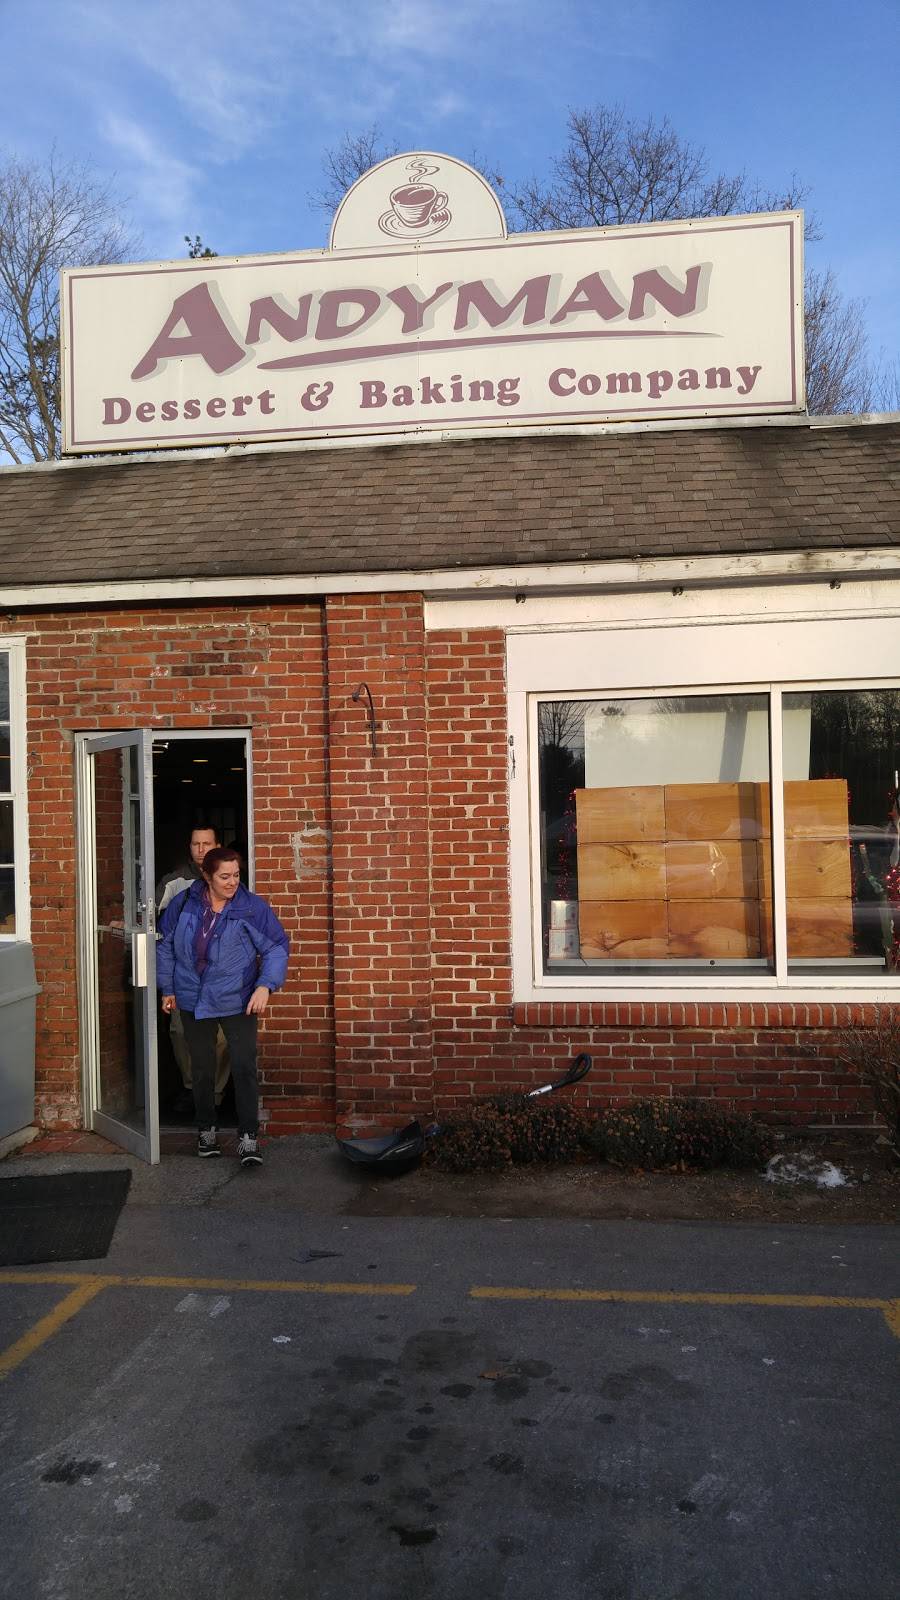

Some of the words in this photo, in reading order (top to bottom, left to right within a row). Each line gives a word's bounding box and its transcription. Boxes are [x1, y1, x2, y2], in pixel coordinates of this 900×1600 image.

[131, 263, 712, 382] ANDYMAN
[102, 389, 276, 425] Dessert
[300, 381, 334, 412] &
[360, 375, 521, 409] Baking
[549, 365, 763, 399] Company
